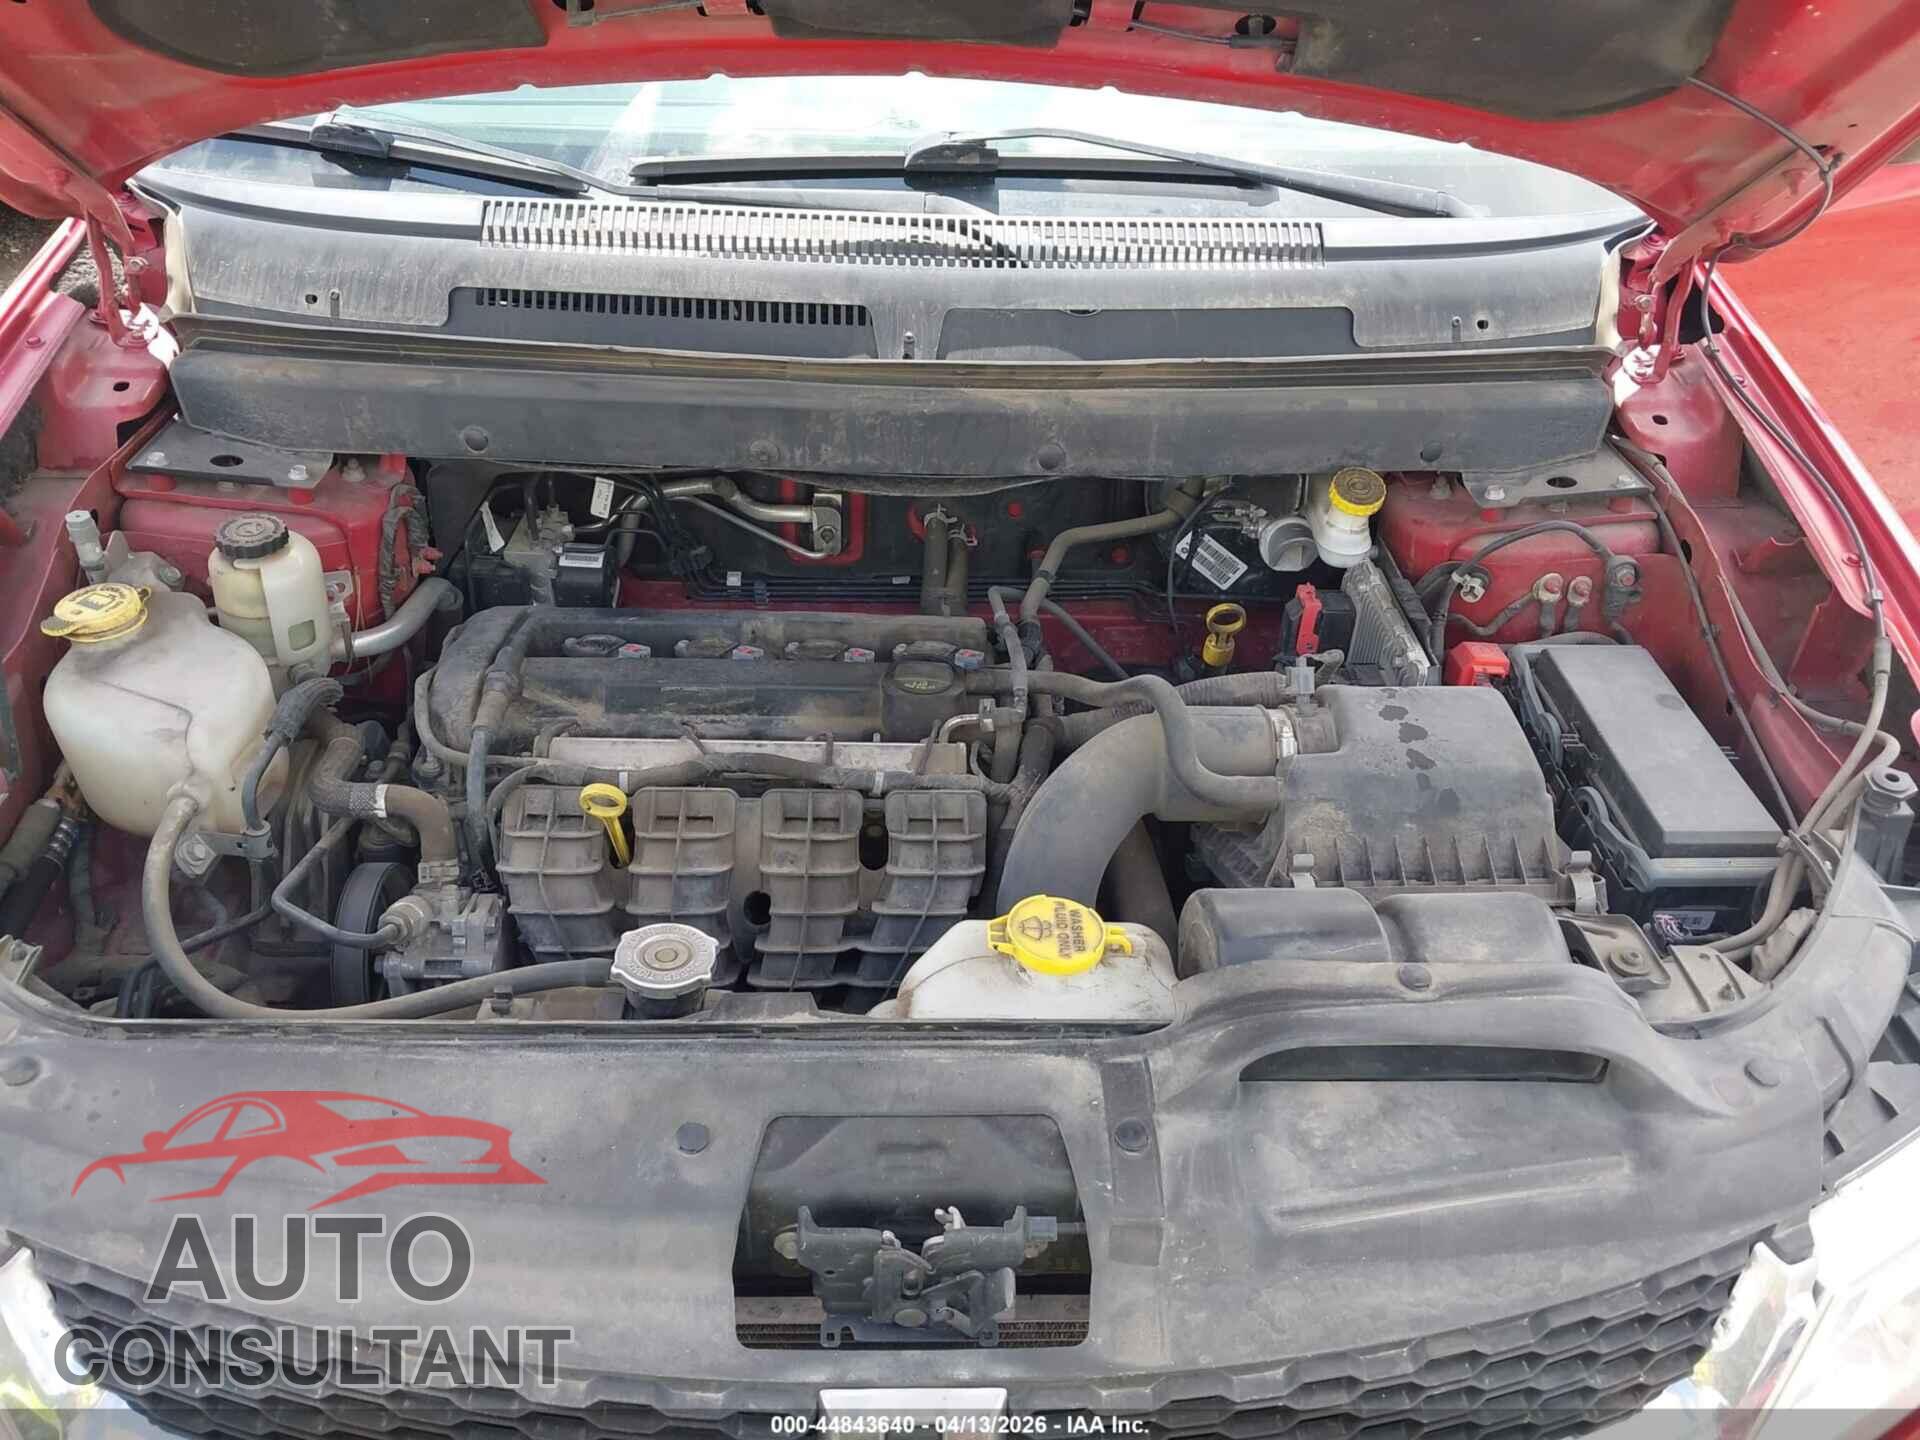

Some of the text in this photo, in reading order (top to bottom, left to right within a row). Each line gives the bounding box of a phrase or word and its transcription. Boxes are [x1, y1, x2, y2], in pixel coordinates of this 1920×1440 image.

[1053, 900, 1072, 959] FLUID ONLY
[1069, 909, 1086, 953] WASHER
